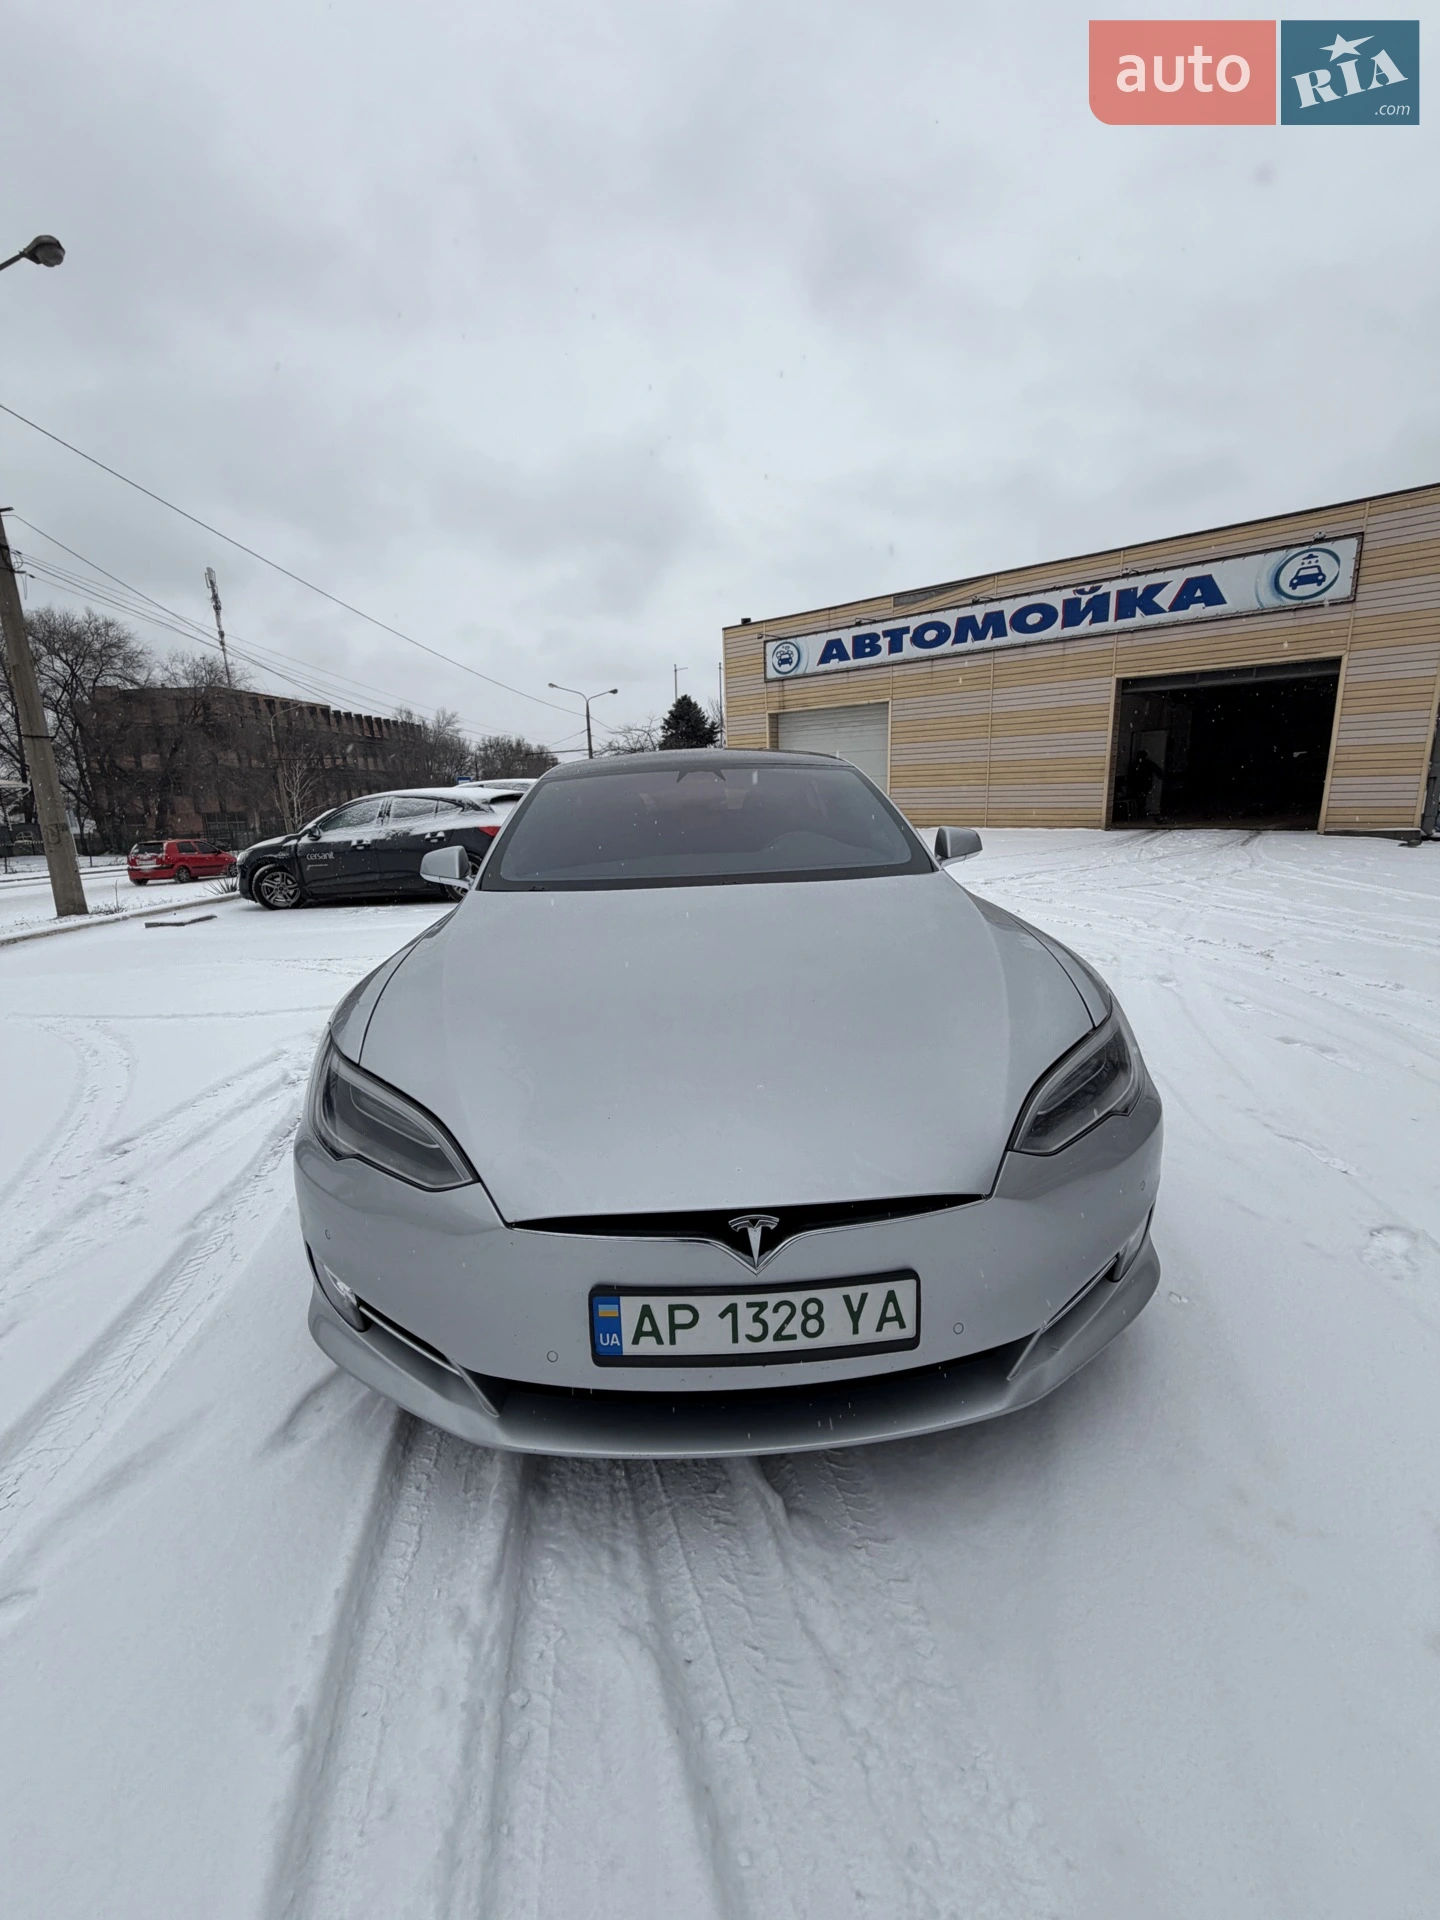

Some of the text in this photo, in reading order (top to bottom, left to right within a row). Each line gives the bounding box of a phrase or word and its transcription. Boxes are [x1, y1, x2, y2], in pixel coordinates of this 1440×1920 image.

[816, 573, 1228, 667] АВТОМОЙКА
[599, 1333, 621, 1347] UA
[631, 1289, 907, 1346] AP 1328 YA
